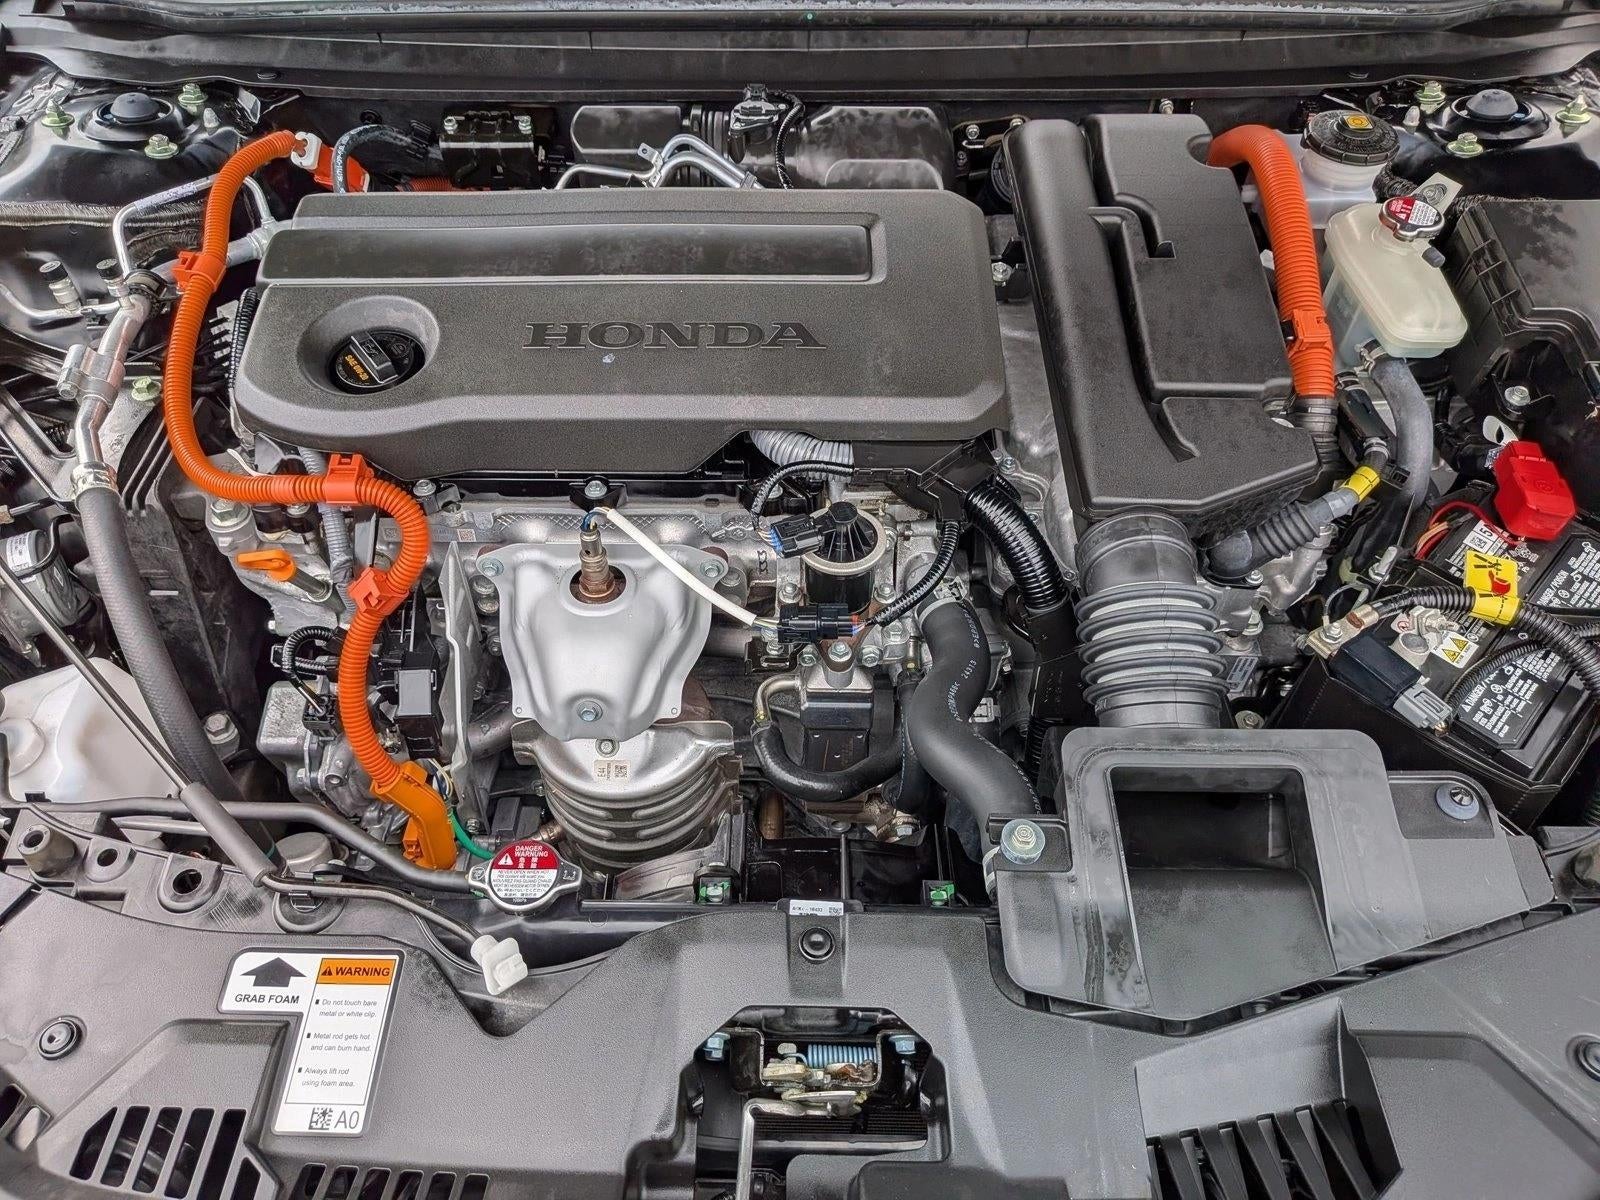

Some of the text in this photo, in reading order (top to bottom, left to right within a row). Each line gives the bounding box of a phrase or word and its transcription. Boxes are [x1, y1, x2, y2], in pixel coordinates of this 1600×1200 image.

[522, 321, 827, 350] HONDA
[335, 967, 390, 977] WARNING
[234, 994, 299, 1004] GRAB FOAM
